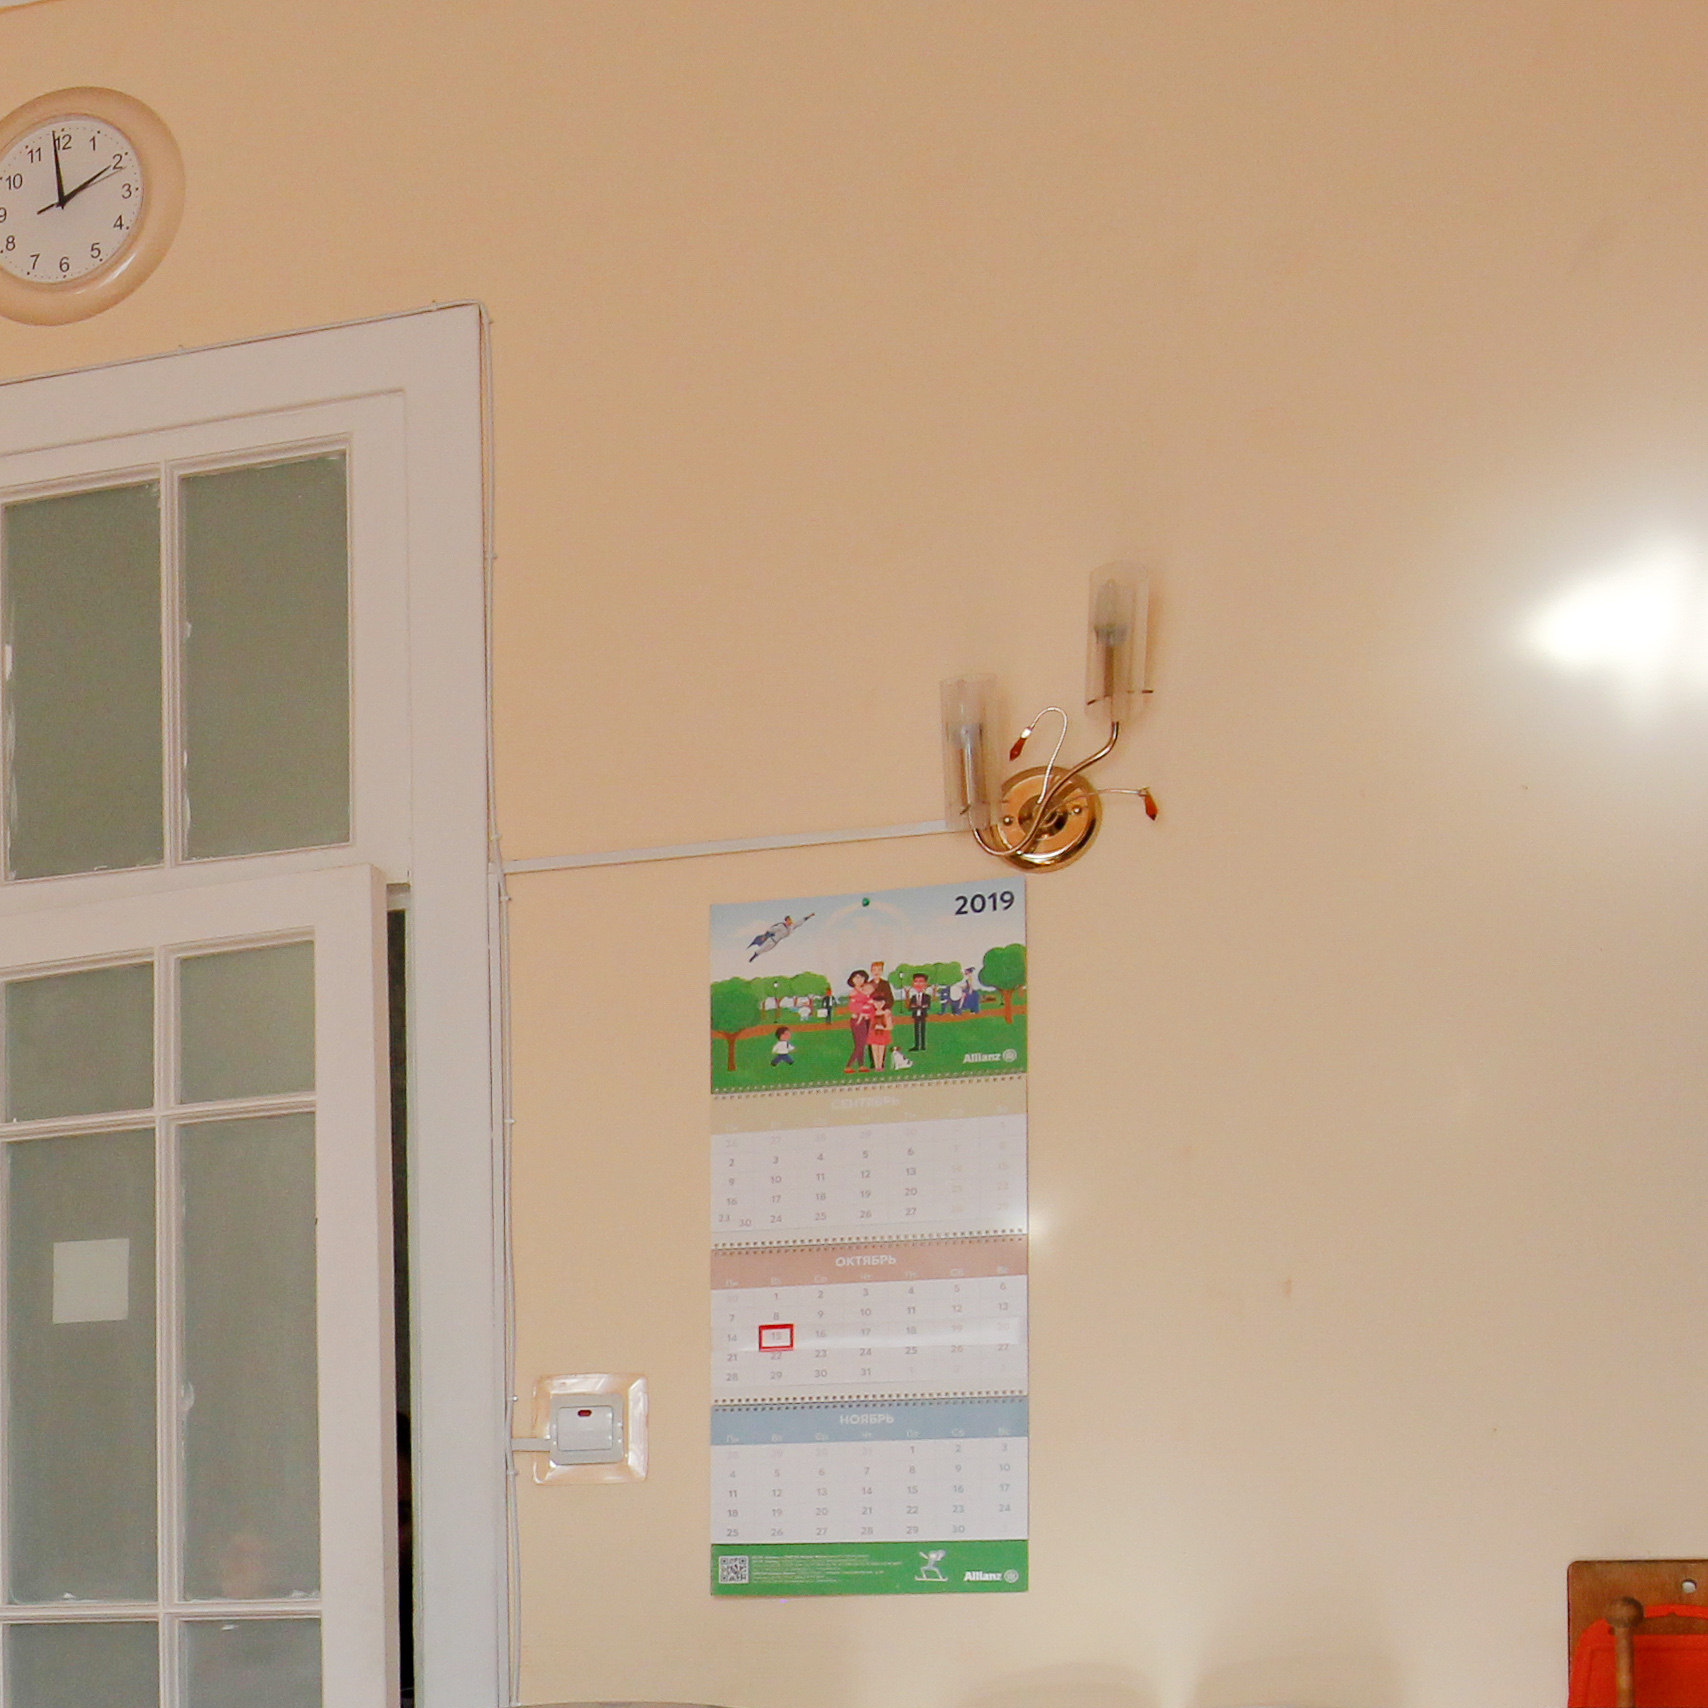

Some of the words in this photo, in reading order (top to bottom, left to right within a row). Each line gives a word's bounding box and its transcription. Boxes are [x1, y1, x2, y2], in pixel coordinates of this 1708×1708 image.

[55, 134, 72, 150] 12
[89, 136, 96, 151] 1
[27, 147, 42, 164] 11
[112, 154, 123, 170] 2
[5, 173, 23, 190] 10
[121, 183, 132, 199] 3
[113, 215, 124, 231] 4
[5, 235, 16, 251] 8
[90, 242, 101, 259] 5
[30, 253, 41, 270] 7
[59, 256, 70, 273] 6
[954, 890, 1015, 915] 2019
[963, 1051, 1001, 1064] Allianz
[769, 1175, 782, 1185] 10
[816, 1172, 826, 1182] 11
[859, 1169, 872, 1179] 12
[904, 1166, 918, 1176] 13
[725, 1197, 738, 1207] 16
[769, 1194, 782, 1204] 17
[814, 1192, 827, 1202] 18
[859, 1189, 872, 1199] 19
[904, 1187, 918, 1197] 20
[718, 1213, 731, 1223] 23
[739, 1218, 752, 1228] 30
[769, 1214, 782, 1224] 24
[814, 1212, 827, 1222] 25
[859, 1209, 872, 1219] 26
[904, 1207, 918, 1217] 27
[835, 1254, 897, 1267] ОКТЯБРЬ
[859, 1307, 872, 1317] 10
[906, 1305, 916, 1315] 11
[951, 1304, 964, 1314] 12
[997, 1301, 1010, 1311] 13
[725, 1333, 738, 1343] 14
[770, 1331, 782, 1341] 15
[814, 1329, 827, 1339] 16
[859, 1327, 872, 1337] 17
[904, 1325, 918, 1335] 18
[726, 1352, 738, 1362] 21
[770, 1351, 782, 1361] 22
[814, 1349, 827, 1359] 23
[859, 1347, 872, 1357] 24
[904, 1346, 918, 1356] 25
[951, 1344, 964, 1354] 26
[997, 1342, 1010, 1352] 27
[726, 1372, 738, 1382] 28
[770, 1370, 782, 1380] 29
[814, 1368, 827, 1378] 30
[859, 1367, 872, 1377] 31
[839, 1413, 895, 1425] НОЯБРЬ
[998, 1462, 1011, 1472] 10
[728, 1489, 738, 1499] 11
[770, 1488, 784, 1498] 12
[815, 1487, 828, 1497] 13
[860, 1486, 874, 1496] 14
[906, 1485, 919, 1495] 15
[952, 1484, 965, 1494] 16
[998, 1483, 1011, 1493] 17
[726, 1508, 739, 1518] 18
[770, 1508, 784, 1518] 19
[815, 1507, 828, 1517] 20
[860, 1506, 874, 1516] 21
[906, 1505, 919, 1515] 22
[952, 1504, 965, 1514] 23
[998, 1503, 1011, 1513] 24
[726, 1528, 739, 1538] 25
[770, 1527, 784, 1537] 26
[815, 1526, 828, 1536] 27
[860, 1526, 873, 1536] 28
[906, 1525, 919, 1535] 29
[952, 1524, 965, 1534] 30
[963, 1571, 1002, 1582] Allianz
